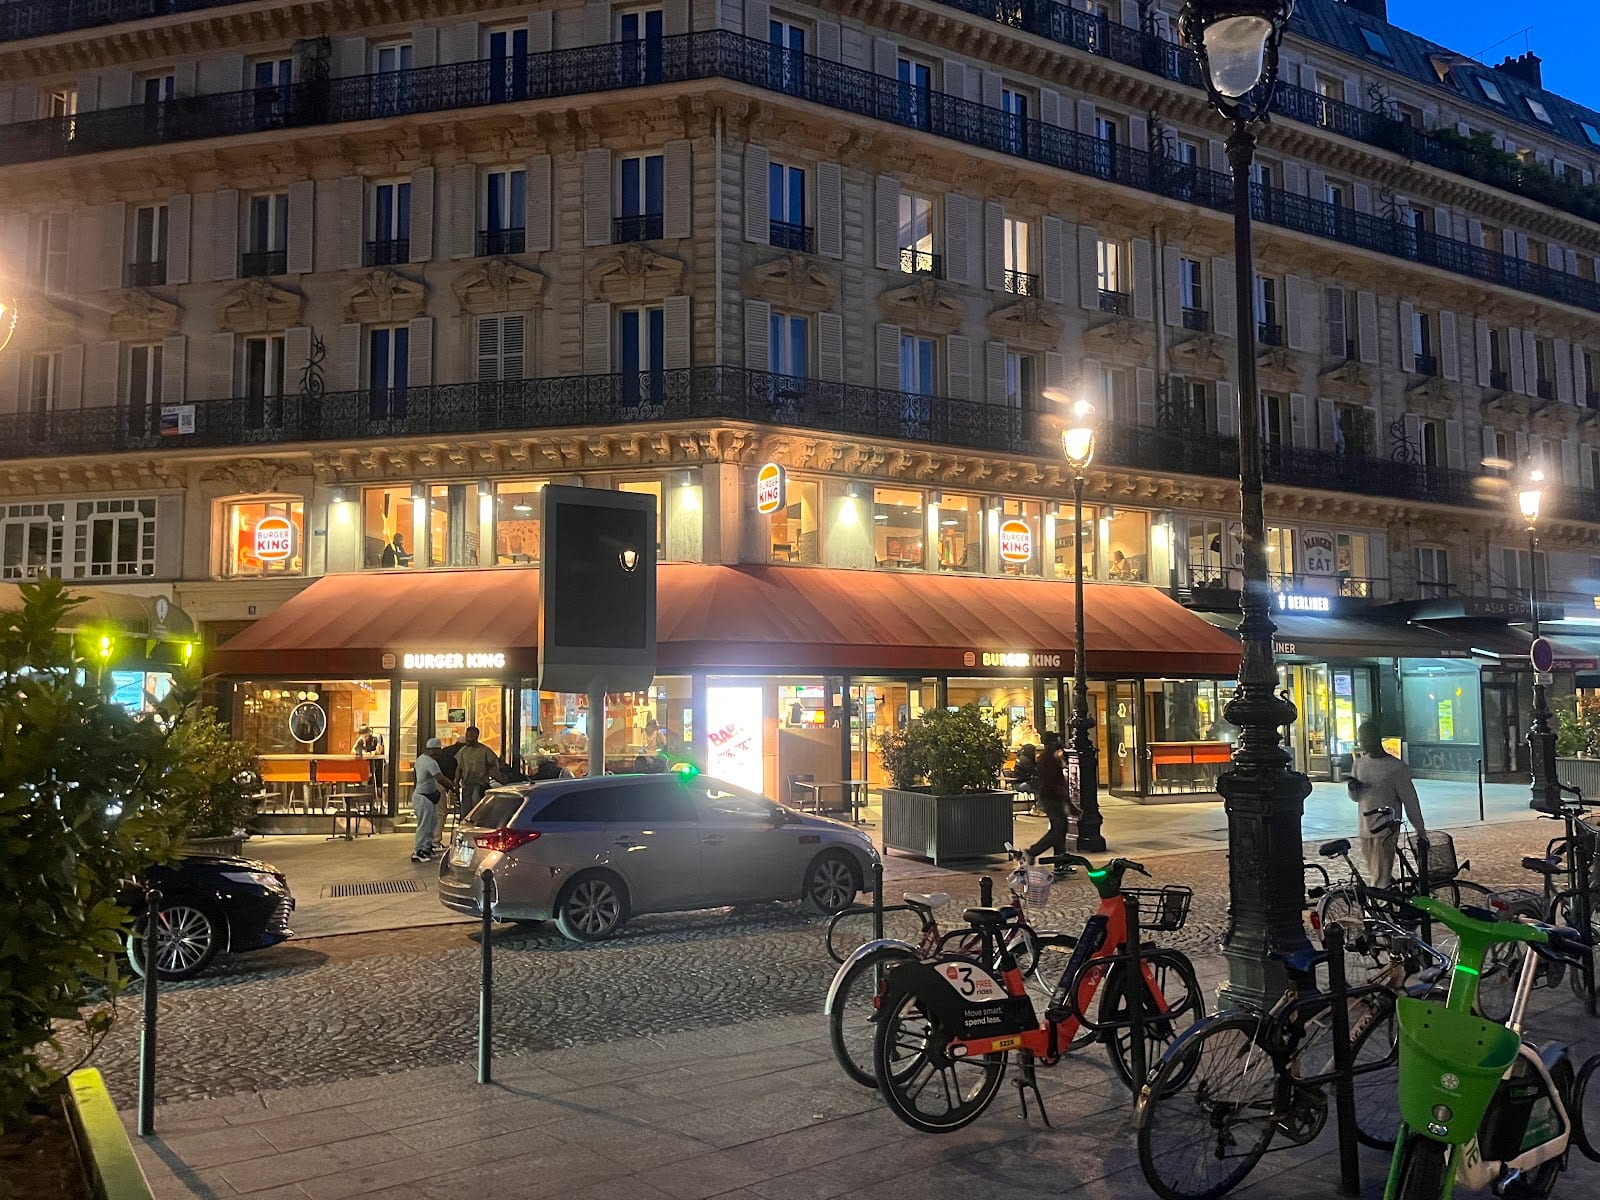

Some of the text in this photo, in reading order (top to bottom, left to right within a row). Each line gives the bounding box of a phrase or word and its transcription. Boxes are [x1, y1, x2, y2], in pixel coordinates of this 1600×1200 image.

[759, 477, 778, 490] BURGER
[759, 487, 778, 504] KING
[257, 530, 289, 539] BURGER
[1001, 533, 1030, 542] BURGER
[257, 539, 289, 550] KING
[1002, 541, 1030, 553] KING
[1308, 558, 1331, 571] EAT
[1287, 595, 1329, 611] BERLINER
[1484, 602, 1505, 614] ASIA
[403, 653, 464, 669] BURGER
[466, 653, 506, 669] KING
[982, 652, 1030, 667] BURGER
[1032, 654, 1061, 667] KING
[958, 967, 975, 996] 3
[976, 979, 992, 988] FREE
[964, 1009, 982, 1018] Move
[964, 1016, 986, 1027] spend
